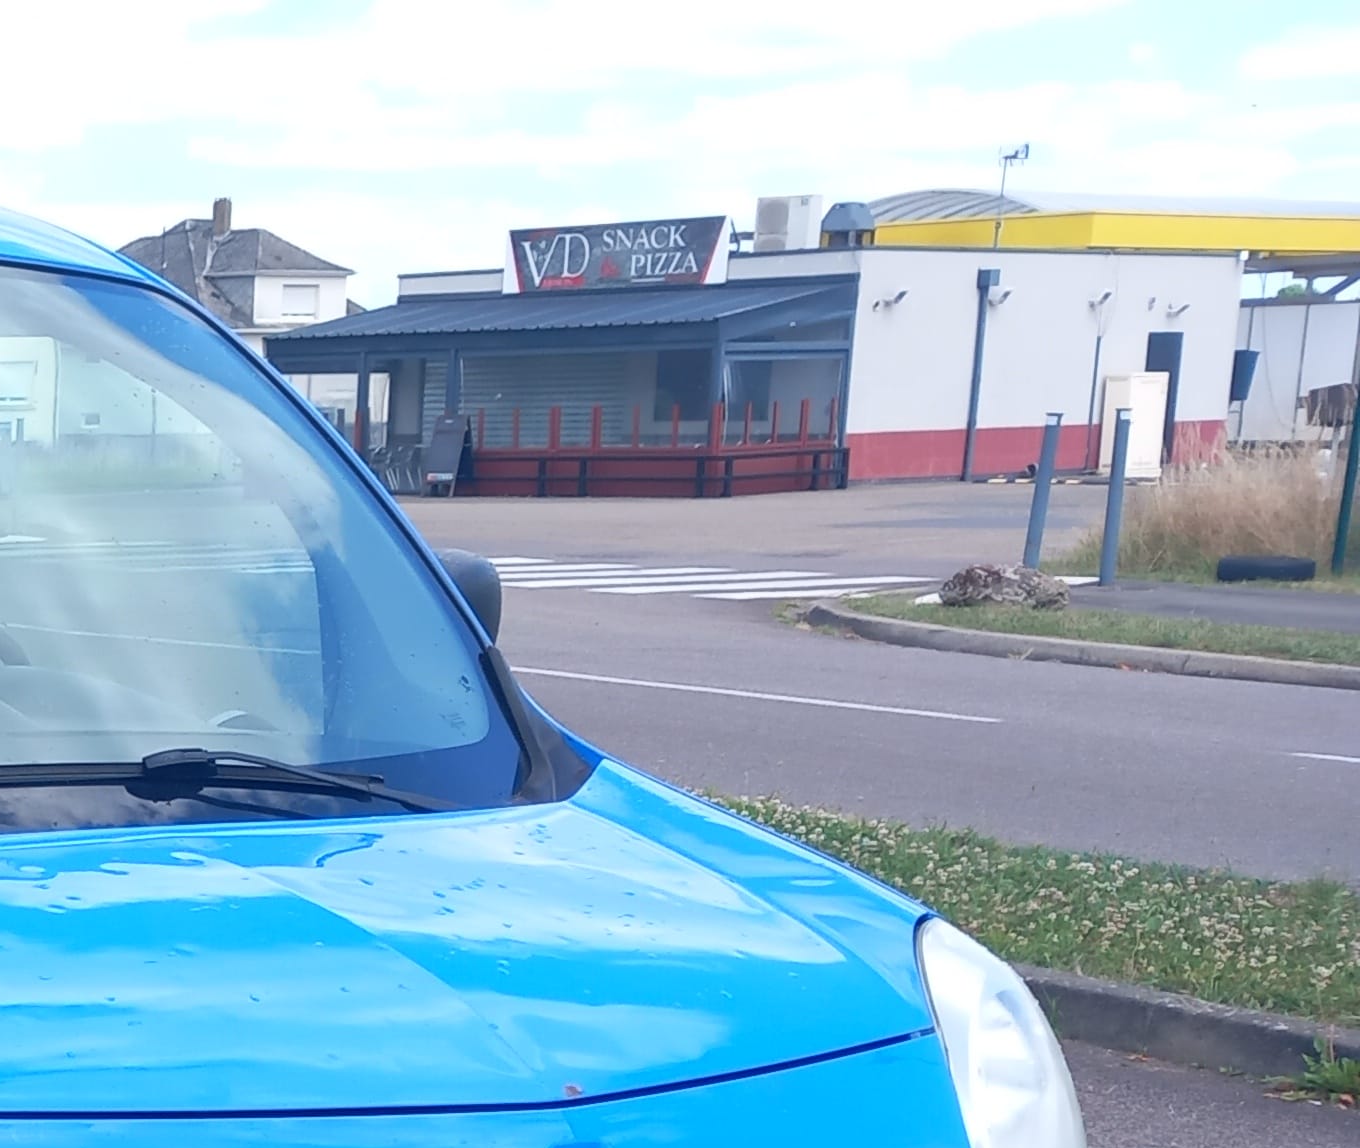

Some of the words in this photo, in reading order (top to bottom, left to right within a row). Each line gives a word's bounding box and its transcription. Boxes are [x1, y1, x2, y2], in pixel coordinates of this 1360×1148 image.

[602, 224, 688, 252] SNACK
[520, 232, 591, 288] VD
[630, 251, 699, 277] PIZZA
